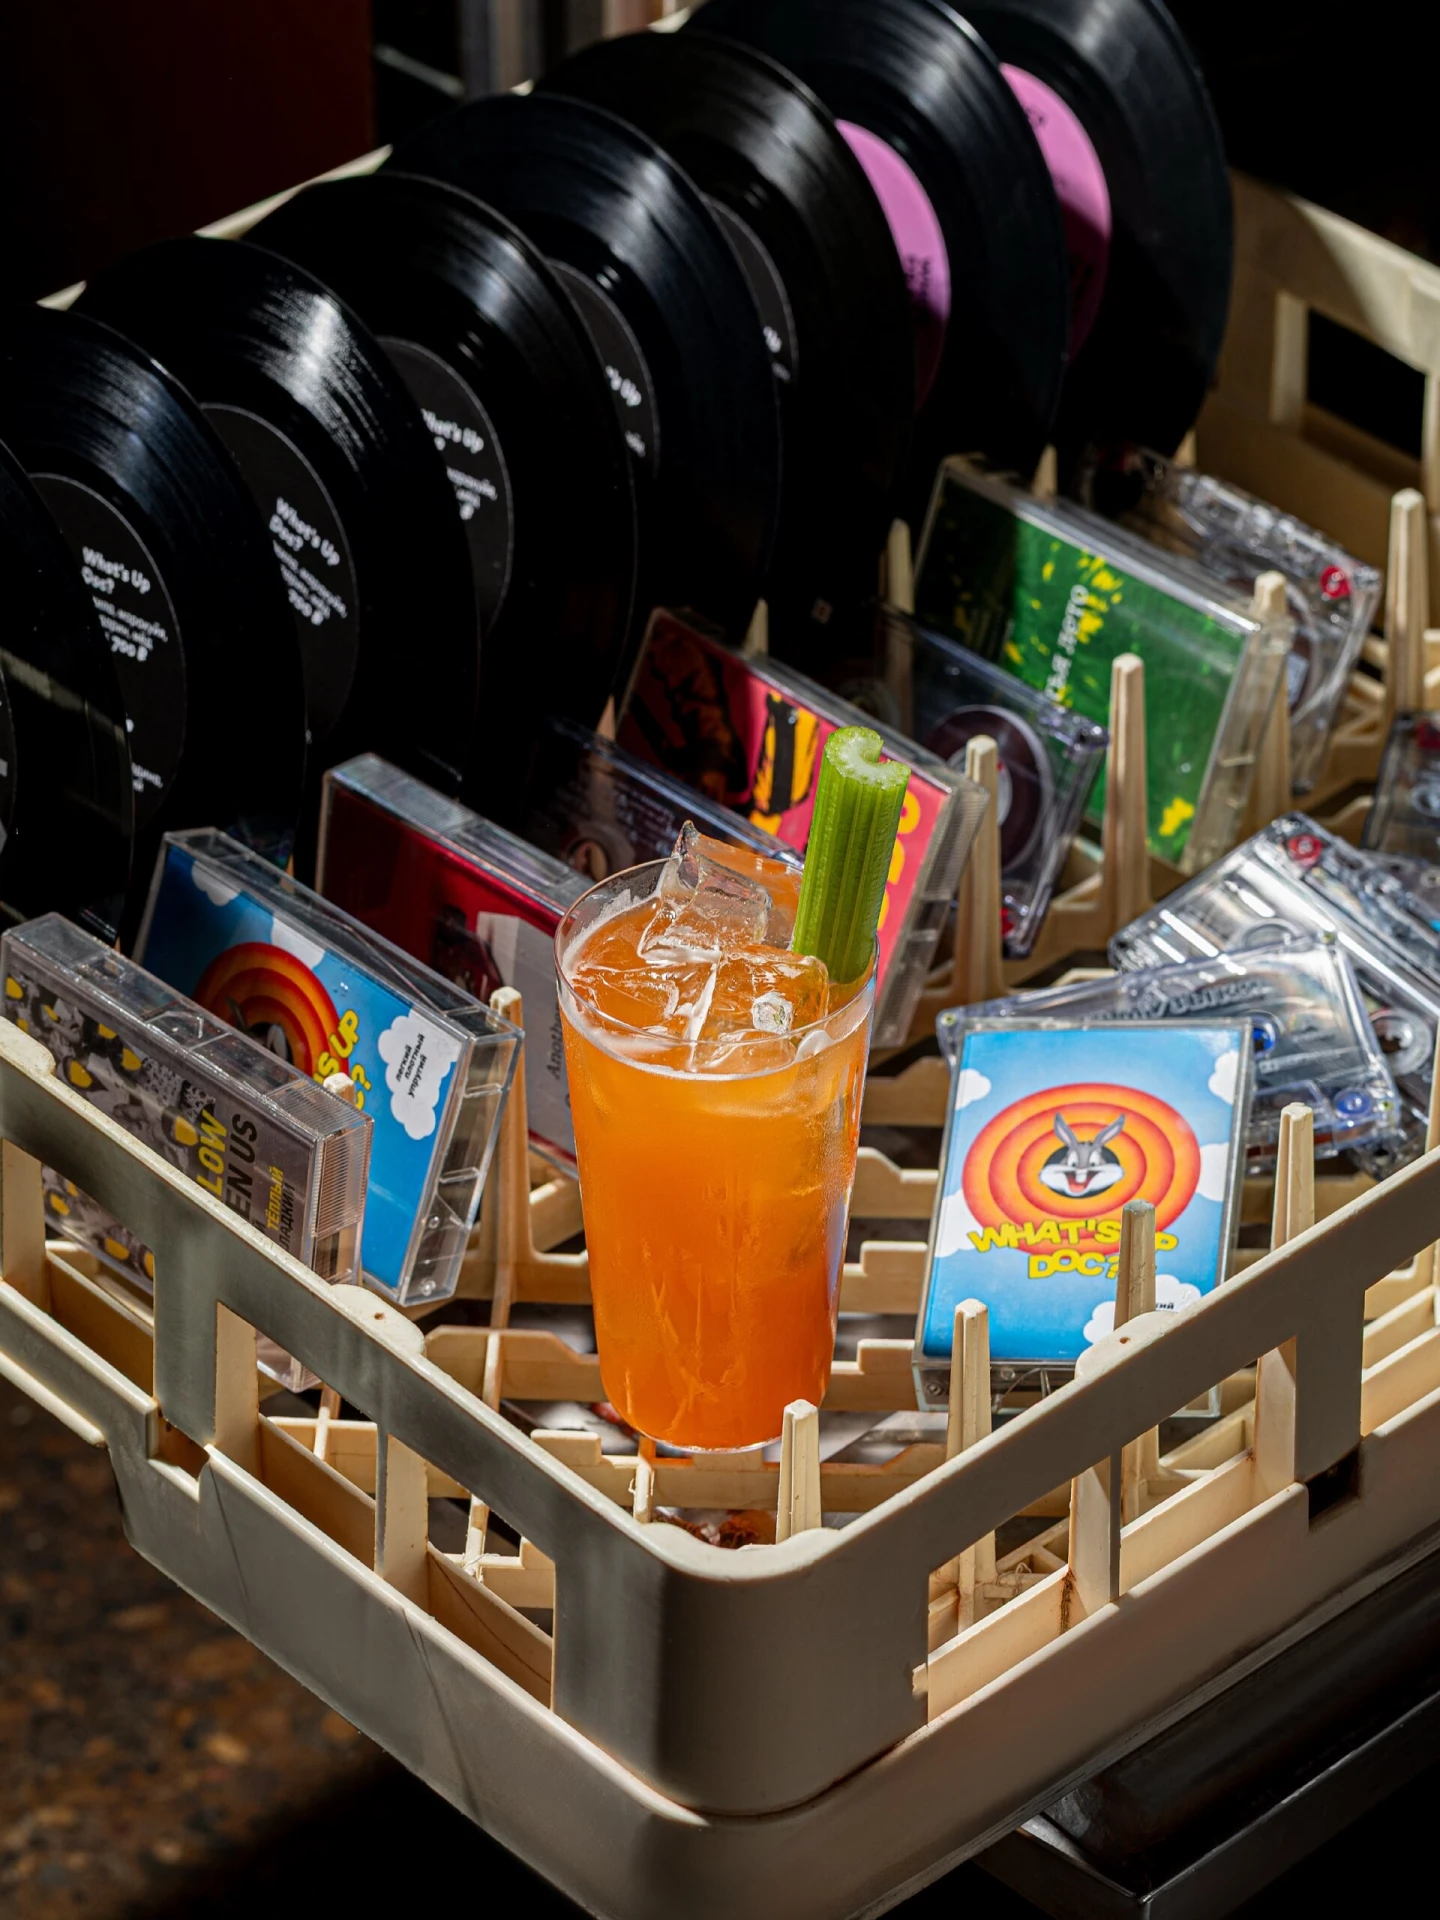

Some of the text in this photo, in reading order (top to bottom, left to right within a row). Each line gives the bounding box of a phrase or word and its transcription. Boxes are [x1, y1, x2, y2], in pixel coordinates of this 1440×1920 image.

[462, 427, 484, 453] Up
[269, 513, 304, 552] Doc?
[275, 496, 341, 567] What's Up
[81, 565, 115, 595] Doc?
[82, 546, 151, 594] What's Up
[329, 1009, 360, 1058] UP
[404, 1033, 425, 1080] плотный
[395, 1044, 412, 1082] легкий
[407, 1053, 428, 1099] упругий
[196, 1109, 228, 1198] LOW
[225, 1113, 258, 1221] EN US
[265, 1165, 284, 1231] ТЁПЛЫЙ
[279, 1181, 295, 1250] ЛАДКИЙ
[967, 1219, 1180, 1253] WHAT'S P
[1027, 1247, 1120, 1280] DOC?
